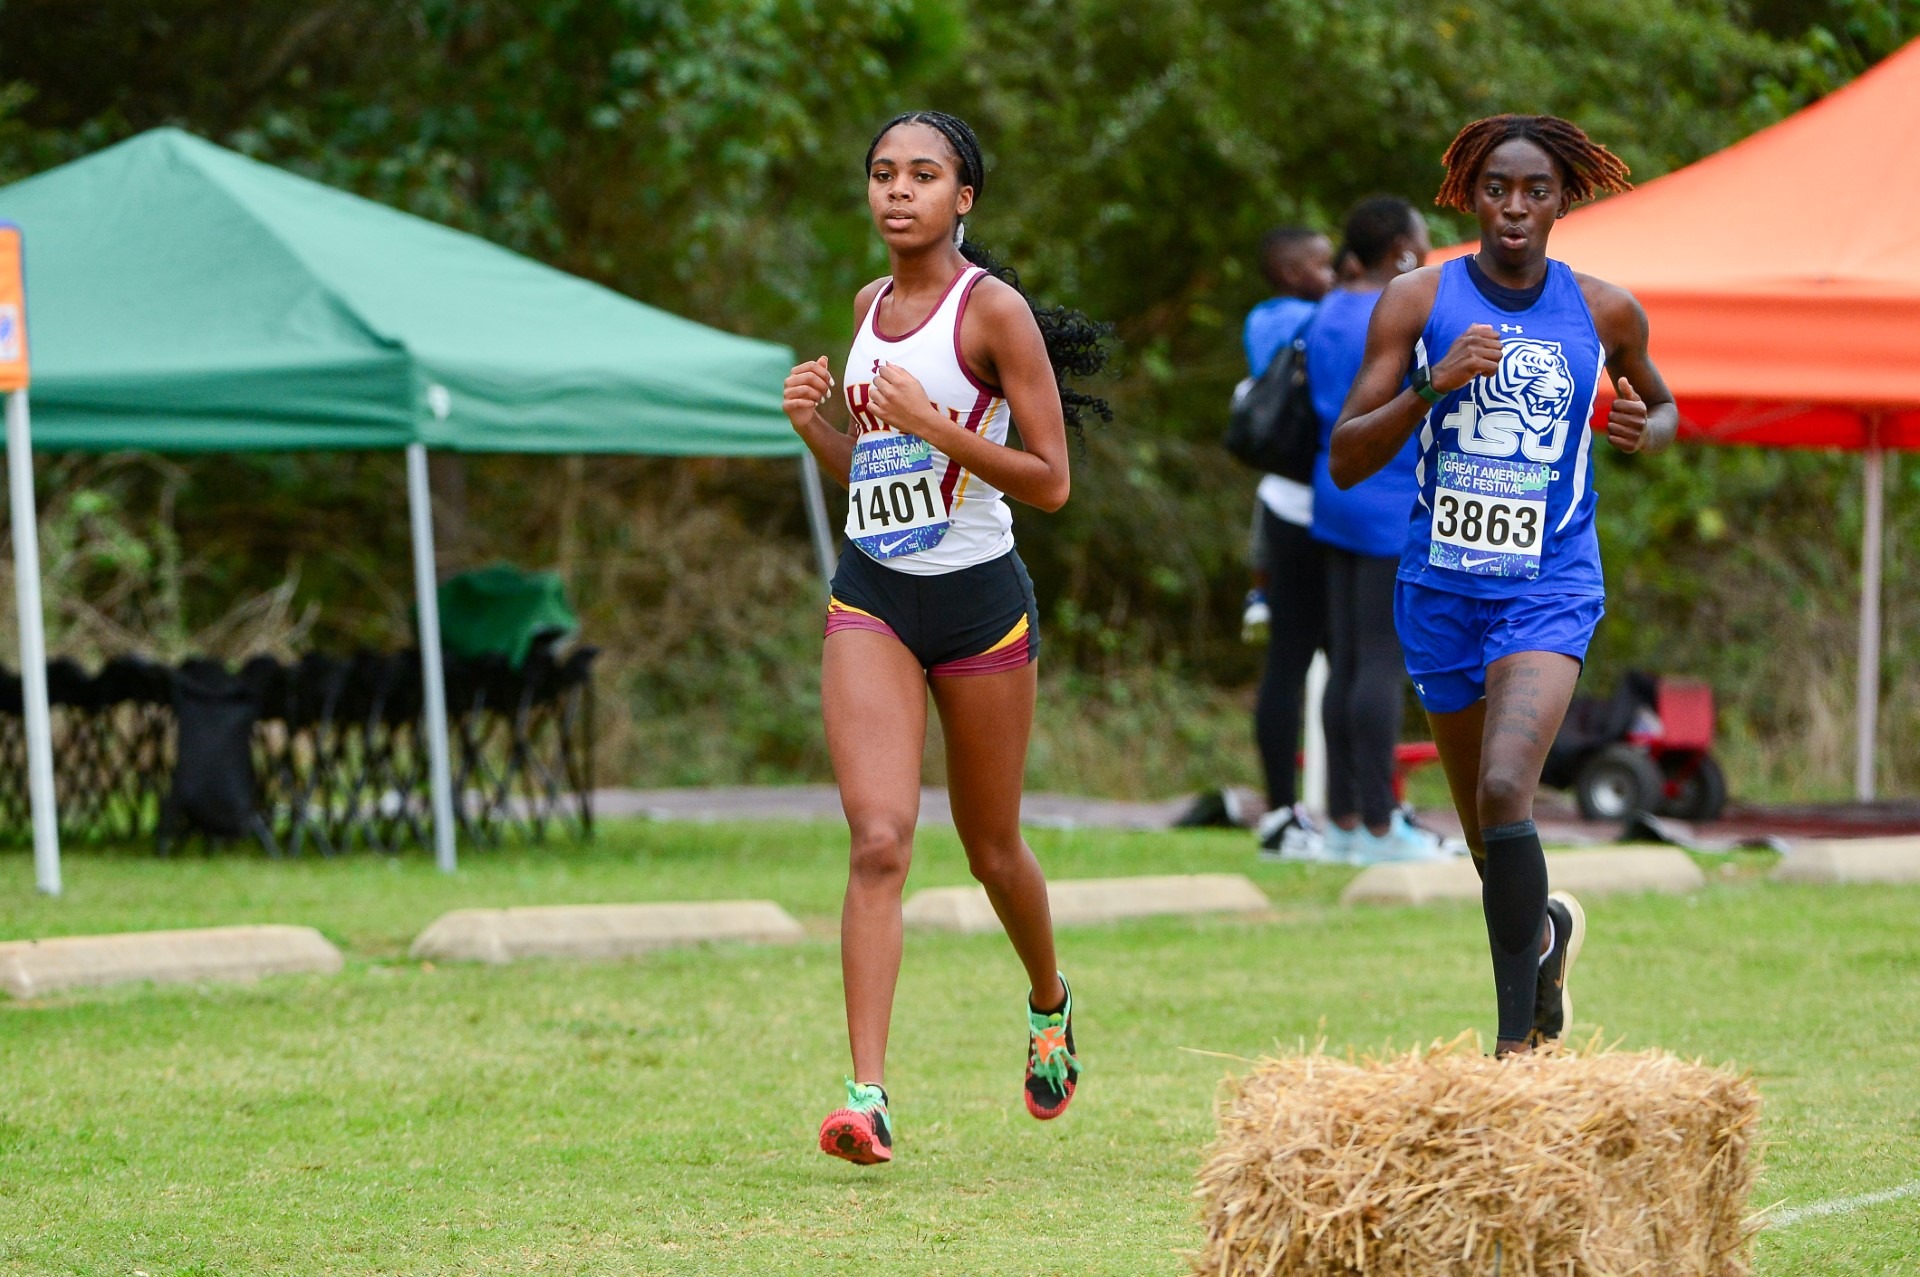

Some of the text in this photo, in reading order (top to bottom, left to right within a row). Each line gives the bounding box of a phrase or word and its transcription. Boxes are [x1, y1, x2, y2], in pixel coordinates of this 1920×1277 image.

[855, 442, 923, 464] GREAT AMERICAN
[869, 457, 912, 474] FESTIVAL
[1444, 461, 1541, 483] GREAT AMERICAN
[1456, 475, 1524, 494] XC FESTIVAL
[852, 477, 935, 530] 1401
[1437, 495, 1538, 548] 3863
